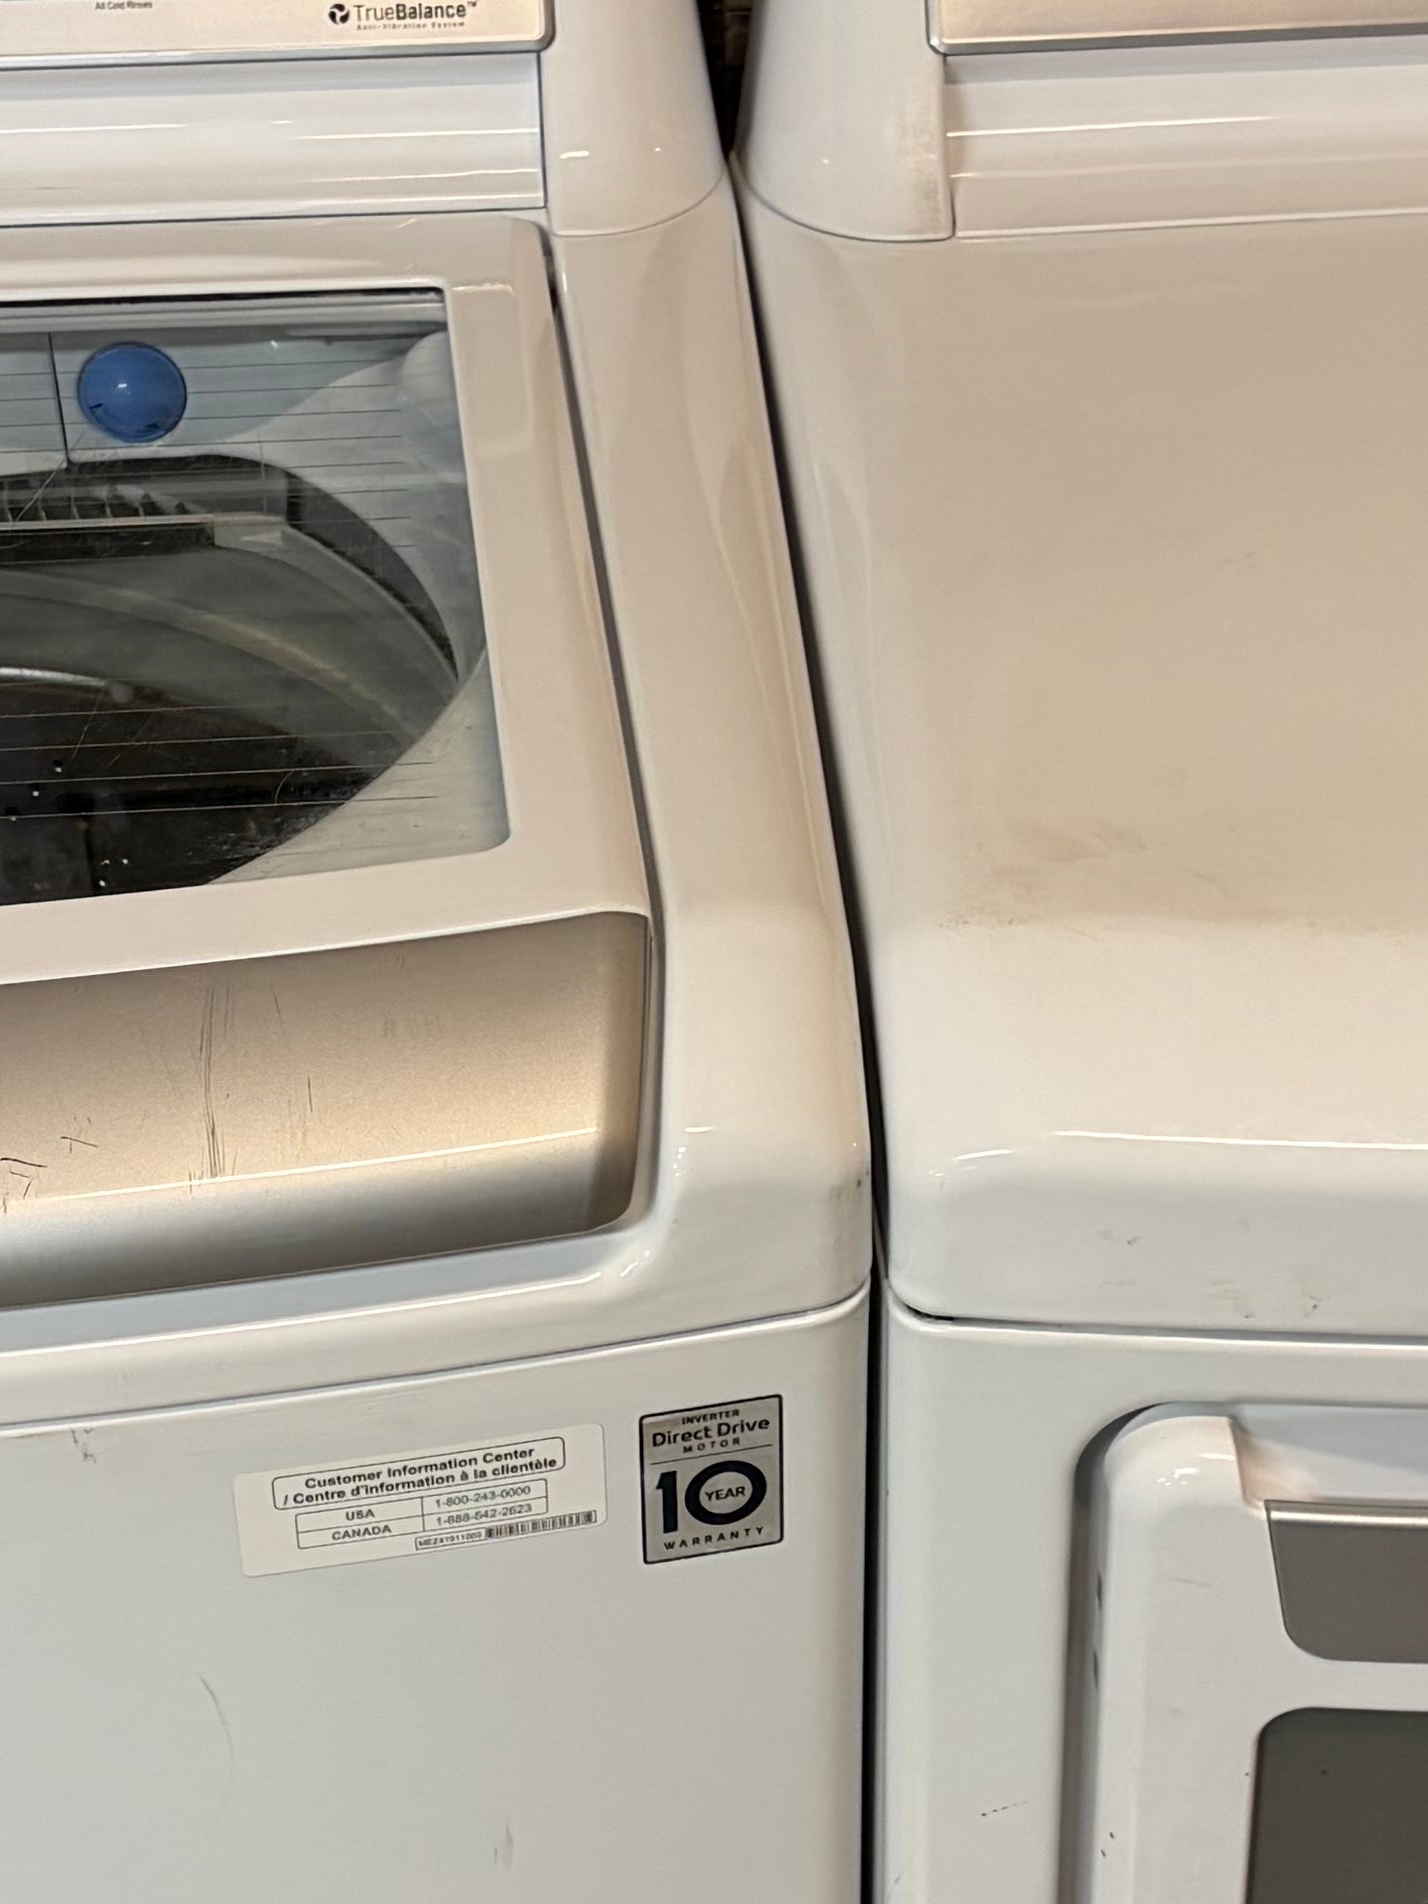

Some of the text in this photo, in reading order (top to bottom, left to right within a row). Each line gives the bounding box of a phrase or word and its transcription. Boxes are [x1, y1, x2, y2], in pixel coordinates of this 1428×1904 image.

[682, 1409, 740, 1425] INVERTER
[652, 1418, 770, 1447] Direct Drive
[683, 1437, 741, 1453] MOTOR
[292, 1489, 347, 1505] Centre
[460, 1470, 469, 1482] à
[473, 1467, 487, 1480] la
[491, 1458, 557, 1477] clientèle
[305, 1447, 535, 1490] Customer Information Center
[345, 1485, 531, 1521] USA 1-800-243-0000
[656, 1460, 767, 1534] 10
[705, 1486, 746, 1502] YEAR
[332, 1524, 392, 1541] CANADA
[664, 1527, 764, 1550] WARRANTY
